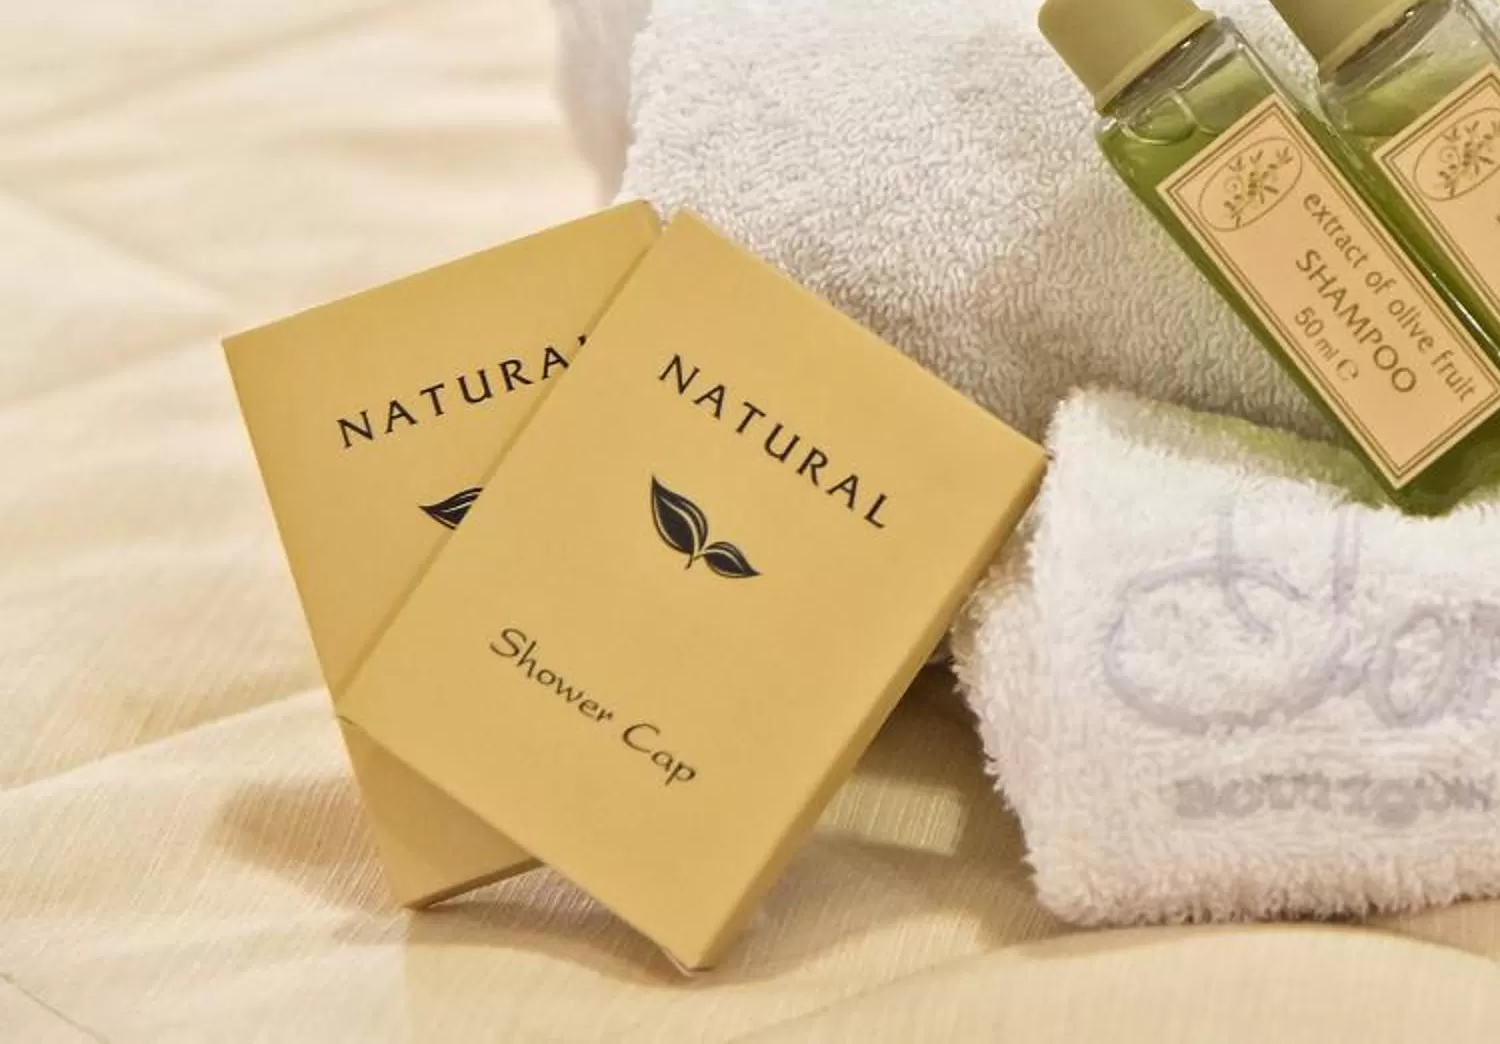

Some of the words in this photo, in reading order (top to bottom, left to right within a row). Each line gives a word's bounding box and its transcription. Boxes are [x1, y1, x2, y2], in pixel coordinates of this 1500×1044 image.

[1295, 248, 1418, 394] SHAMPOO
[1302, 191, 1370, 270] extract
[1364, 269, 1397, 296] of
[1387, 298, 1436, 354] olive
[1428, 348, 1479, 403] fruit
[338, 333, 588, 449] NATURA
[657, 353, 888, 530] NATURAL
[488, 626, 614, 723] Shower
[621, 722, 697, 787] Cap
